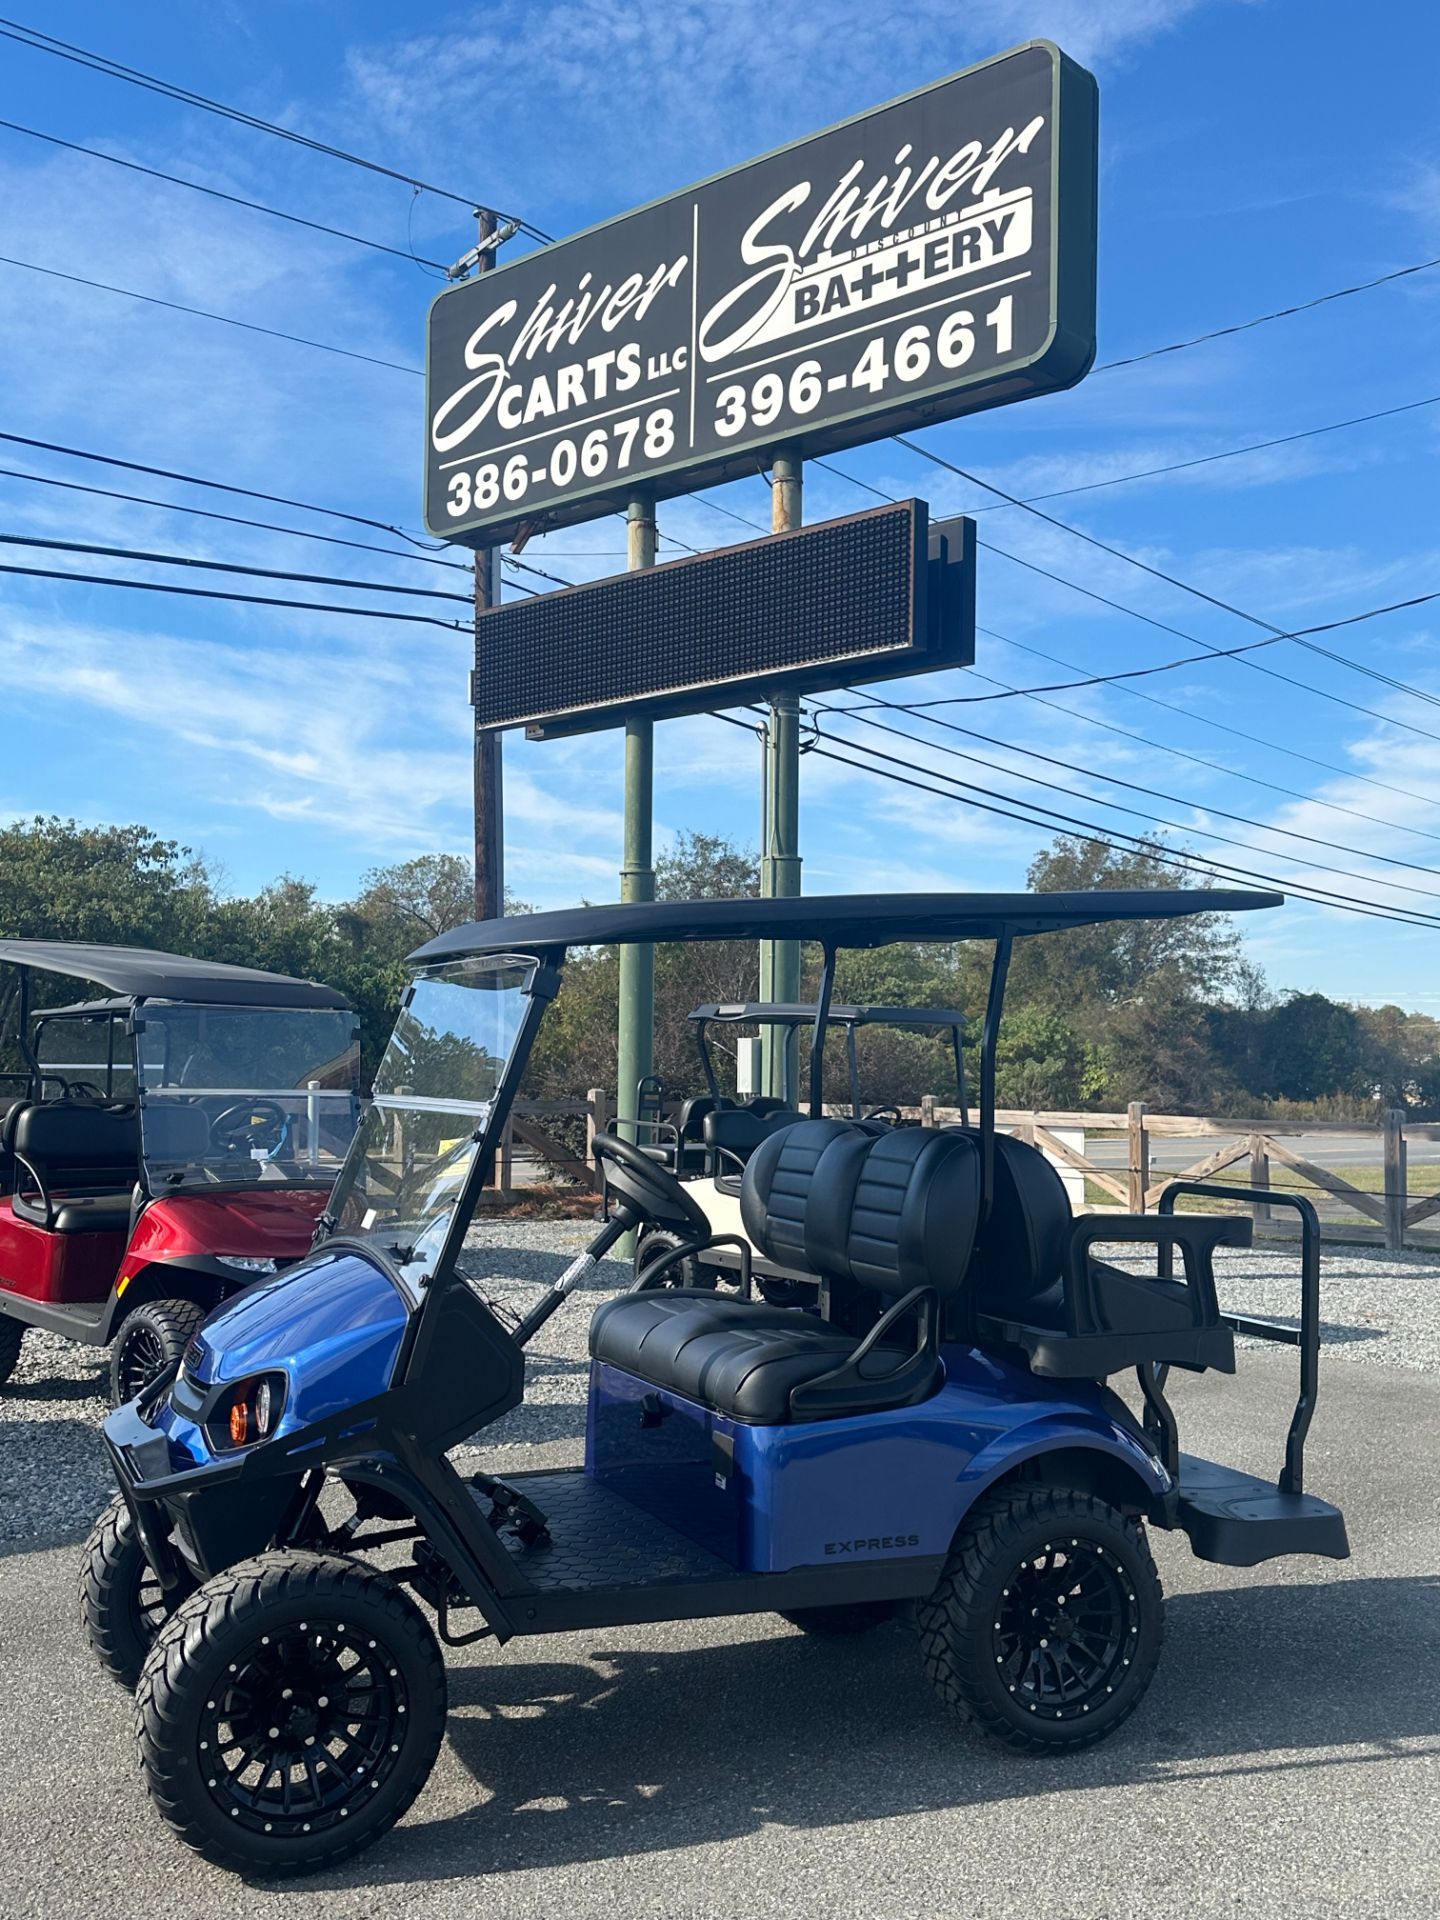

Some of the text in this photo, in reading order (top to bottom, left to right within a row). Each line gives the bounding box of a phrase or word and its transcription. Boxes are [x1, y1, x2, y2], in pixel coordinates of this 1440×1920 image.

[698, 115, 1044, 363] Shiver
[851, 208, 963, 261] DISCOUNT
[432, 255, 689, 453] Shiver
[497, 342, 688, 430] CARTS LLC
[713, 295, 1014, 438] 396-4661
[446, 408, 675, 518] 386-0678
[824, 1535, 920, 1555] EXPRESS
